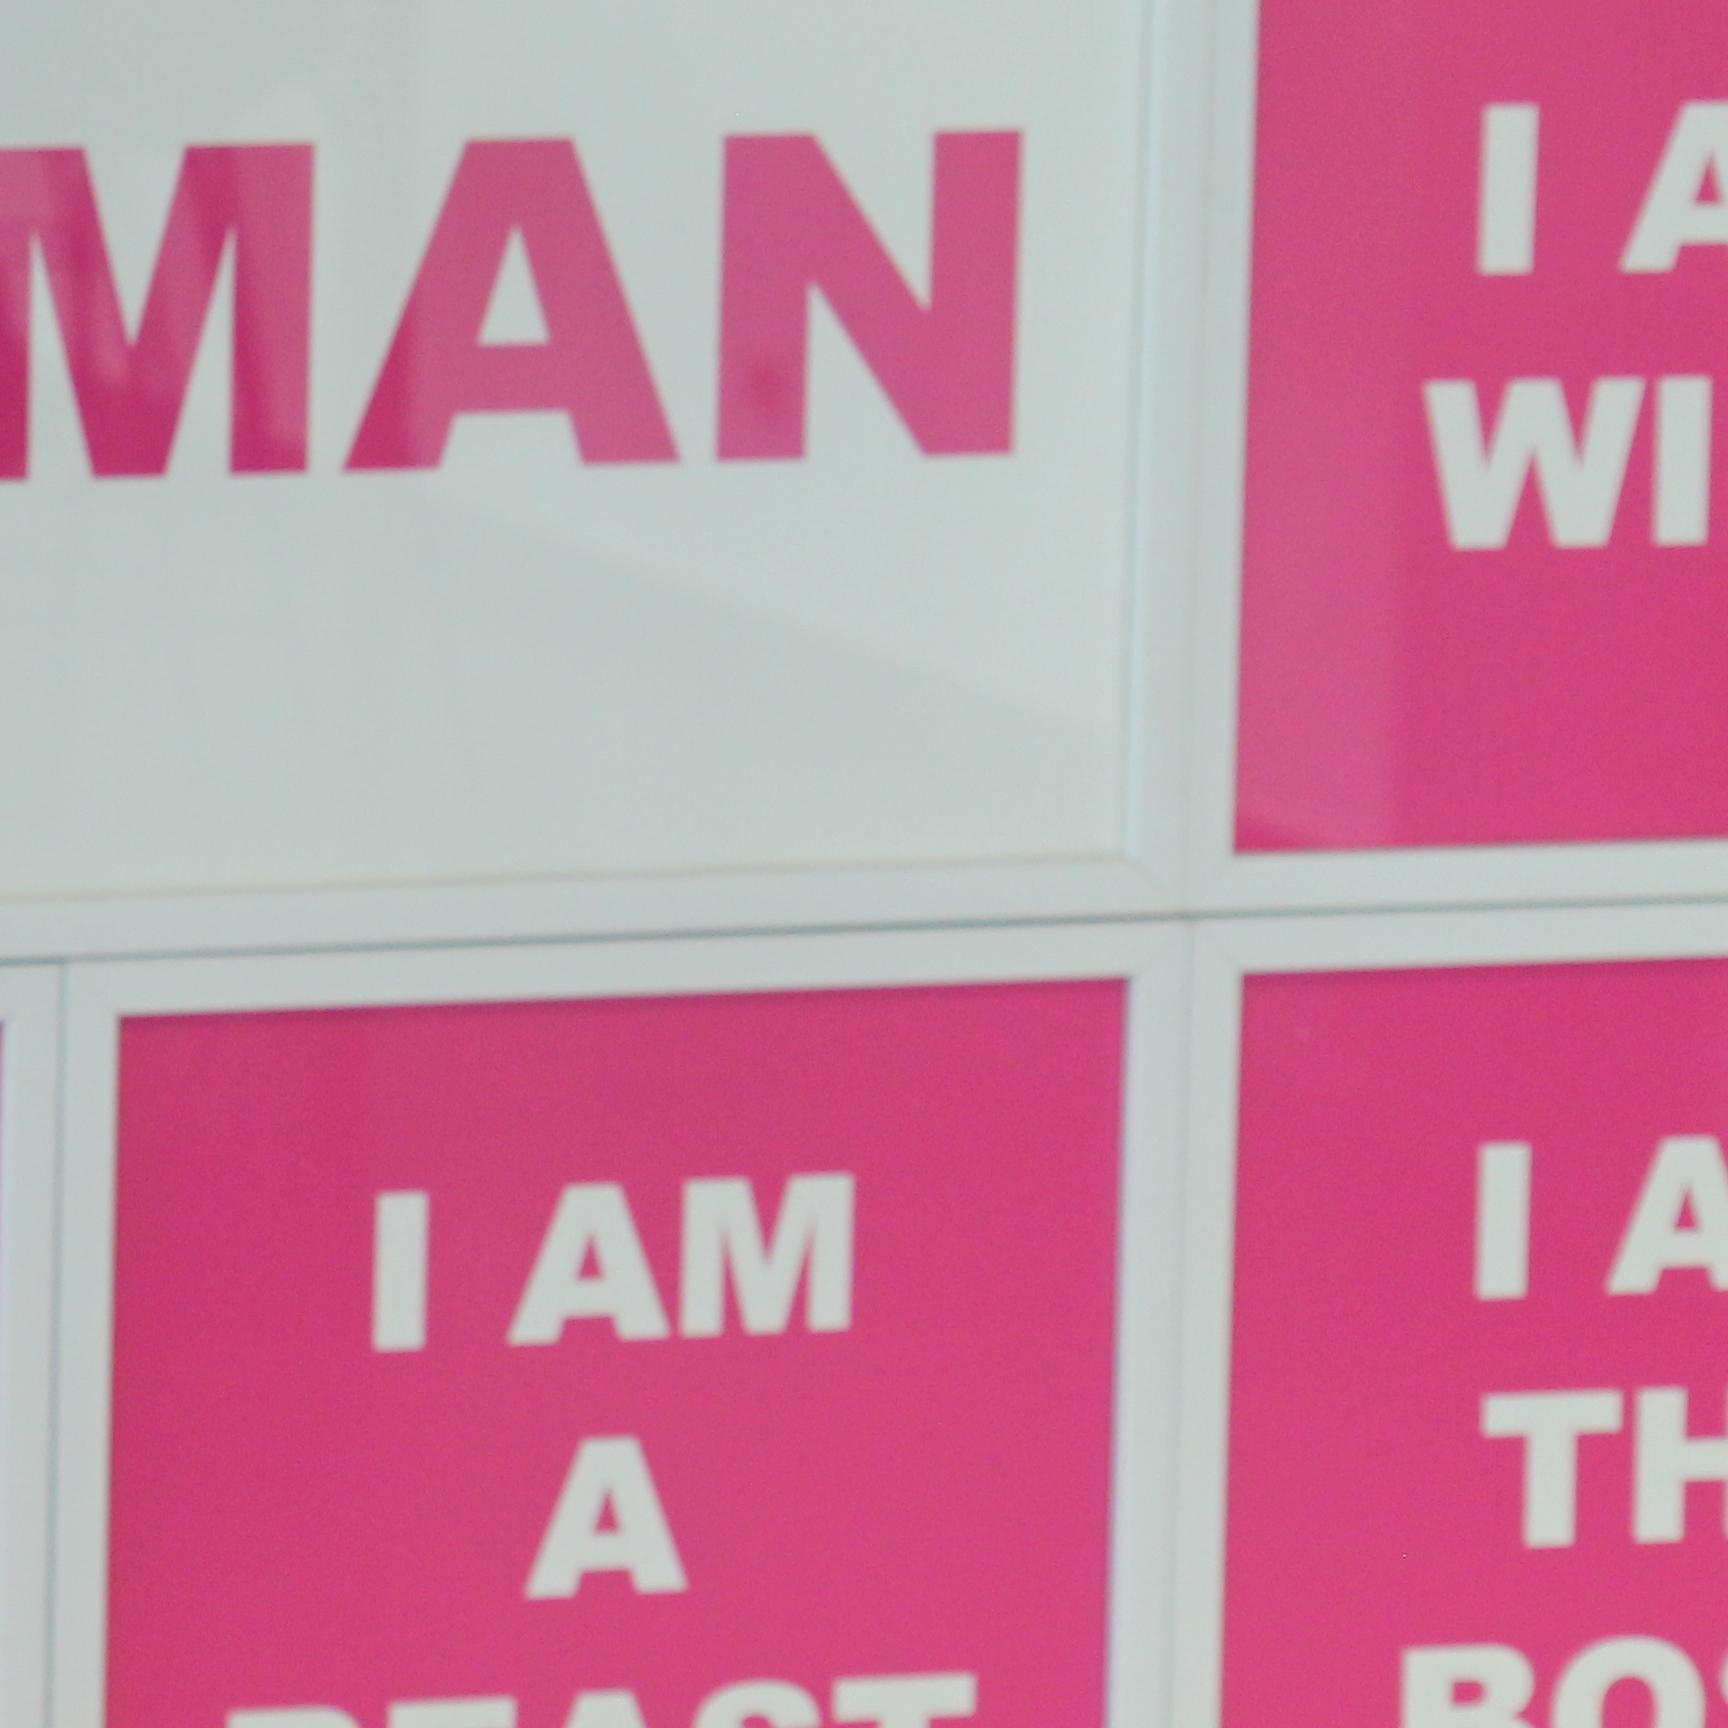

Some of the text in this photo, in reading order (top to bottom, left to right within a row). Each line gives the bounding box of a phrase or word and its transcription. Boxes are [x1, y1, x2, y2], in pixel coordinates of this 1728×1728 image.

[1477, 103, 1539, 275] I
[1423, 374, 1712, 550] WI
[373, 1172, 856, 1352] I AM
[1476, 1141, 1532, 1300] I
[526, 1434, 688, 1600] A
[1401, 1634, 1728, 1728] BO
